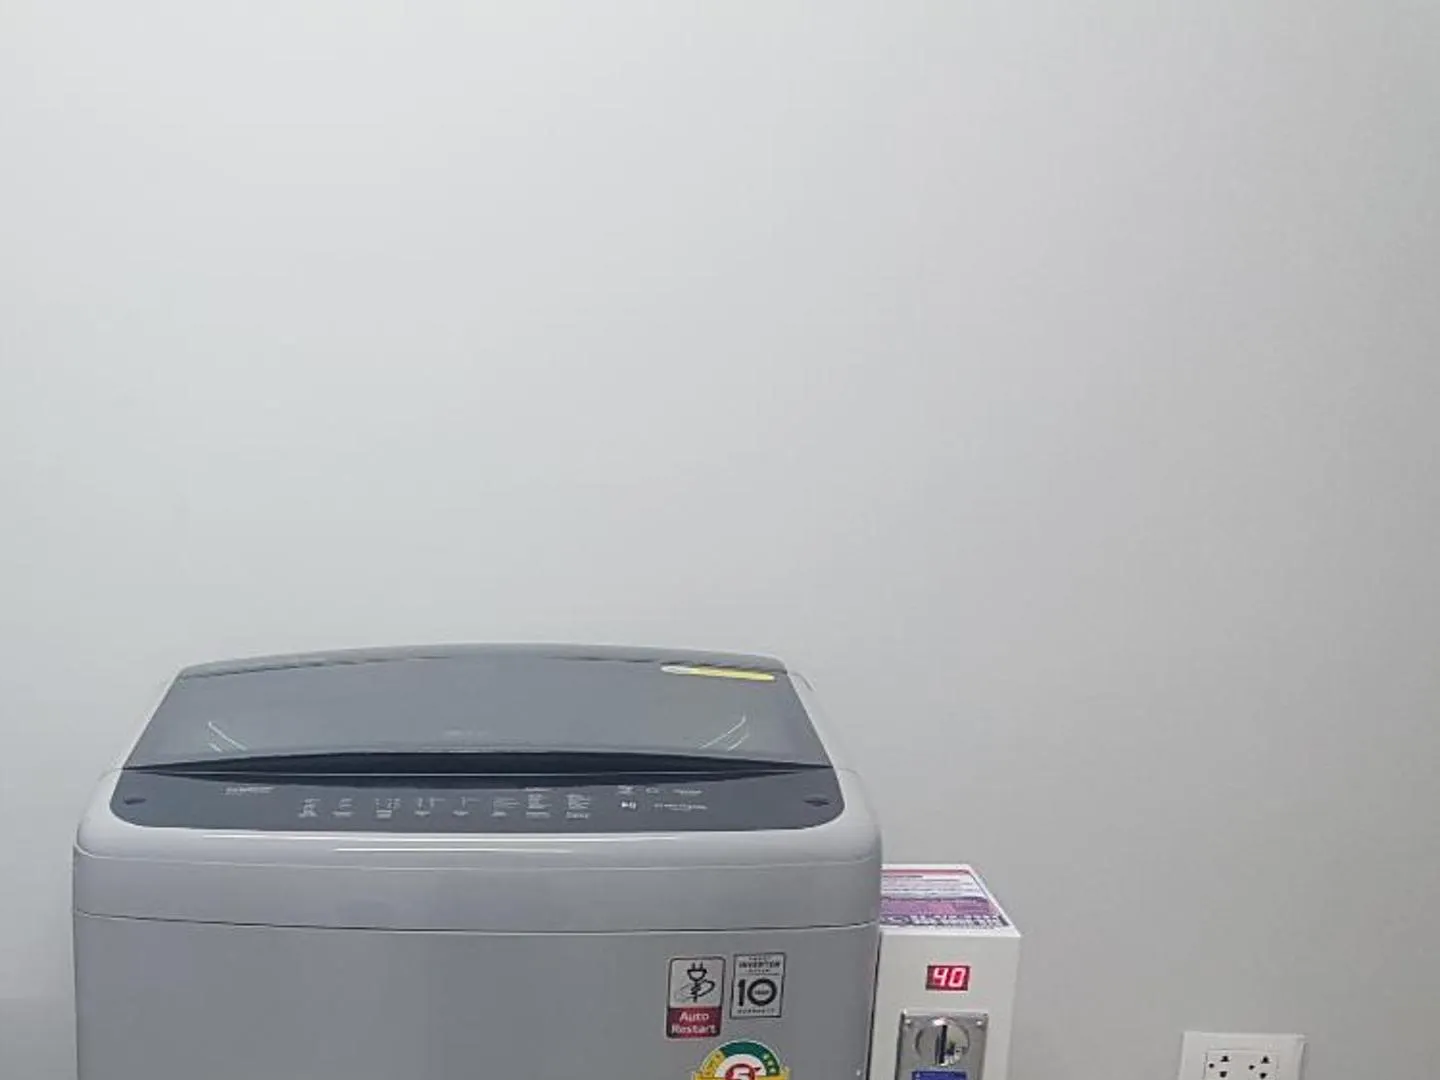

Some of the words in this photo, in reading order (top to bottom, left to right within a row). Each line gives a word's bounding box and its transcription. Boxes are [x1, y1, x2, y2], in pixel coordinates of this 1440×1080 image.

[933, 967, 966, 987] 40
[738, 978, 778, 1006] 10
[679, 1011, 710, 1022] Auto
[671, 1023, 717, 1034] Restart
